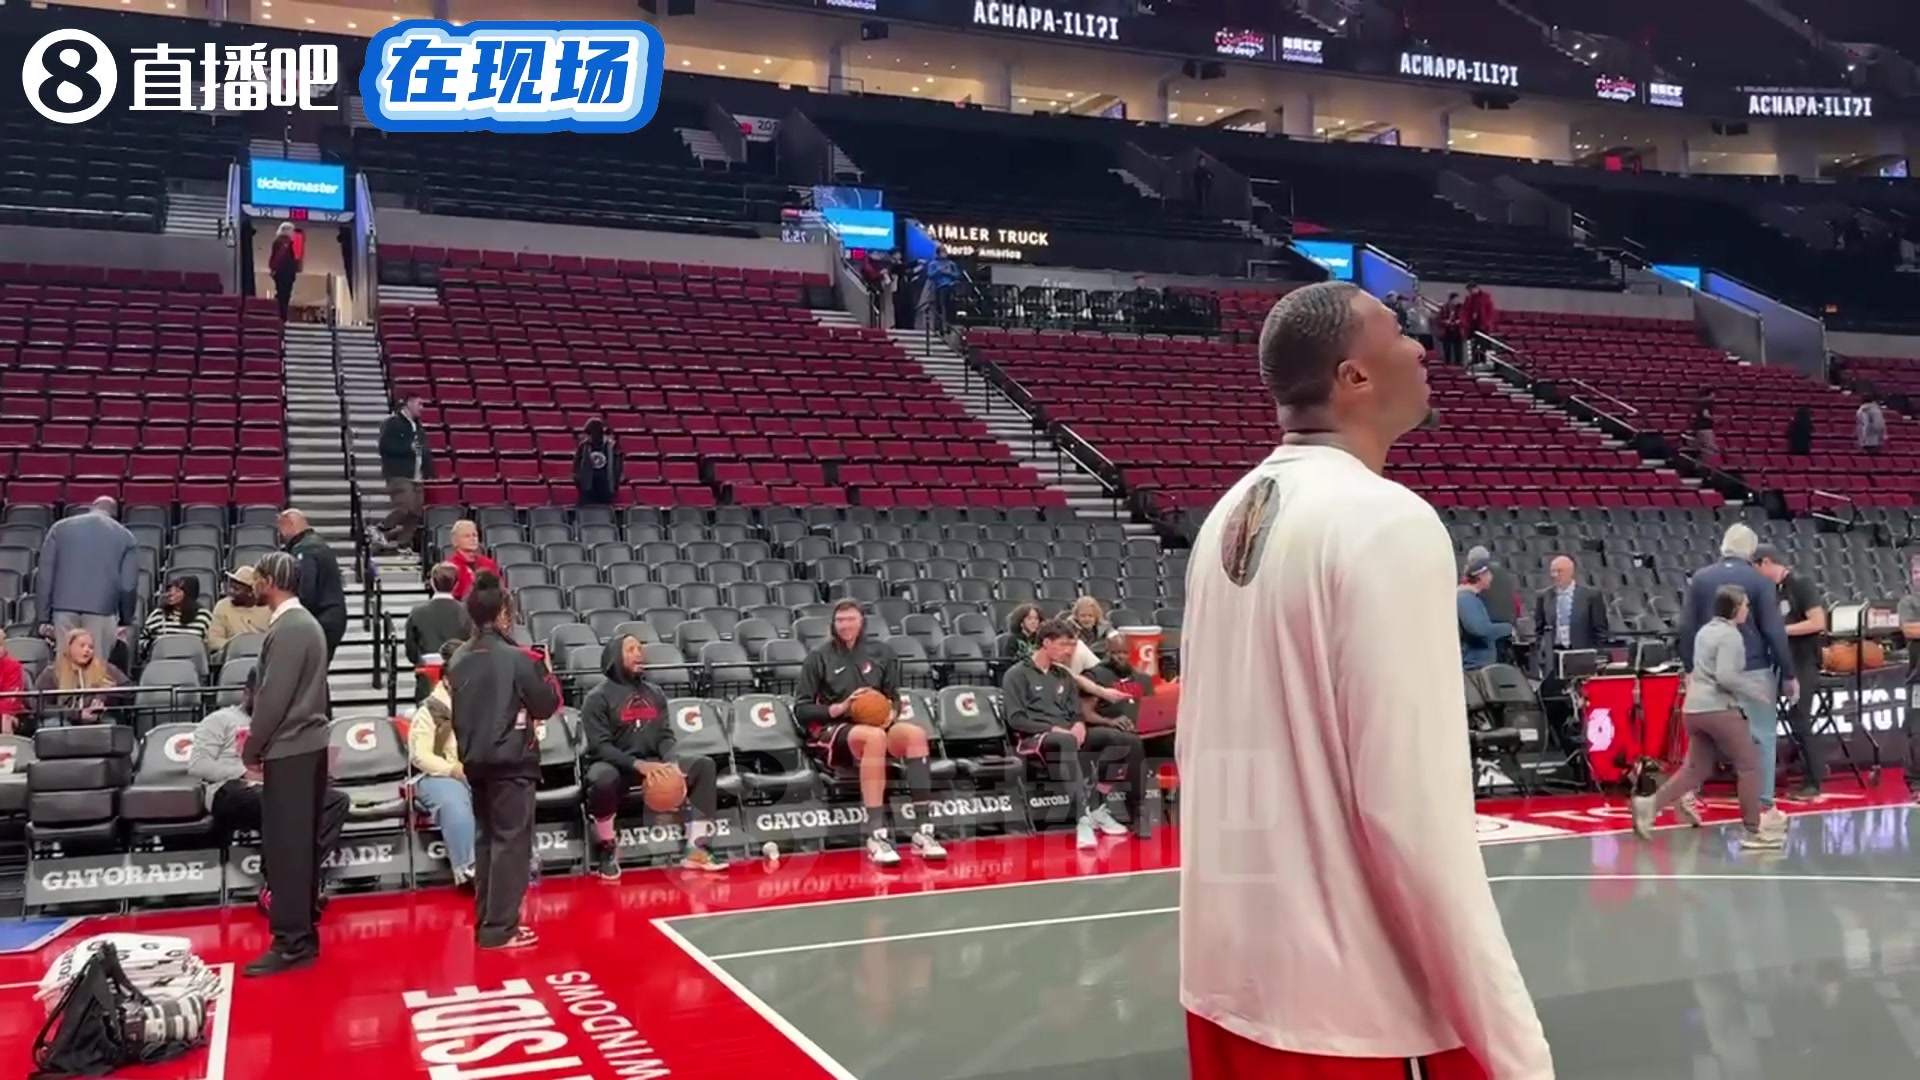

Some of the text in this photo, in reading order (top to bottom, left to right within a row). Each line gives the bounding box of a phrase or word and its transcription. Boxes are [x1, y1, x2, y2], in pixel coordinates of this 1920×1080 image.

[256, 177, 339, 194] ticketmaster
[921, 223, 1049, 246] AIMLER TRUCK
[750, 702, 777, 729] G
[955, 691, 980, 717] G
[677, 706, 703, 733] G
[346, 722, 376, 751] G
[901, 796, 1013, 819] GTORADE
[42, 861, 204, 891] GATORADE
